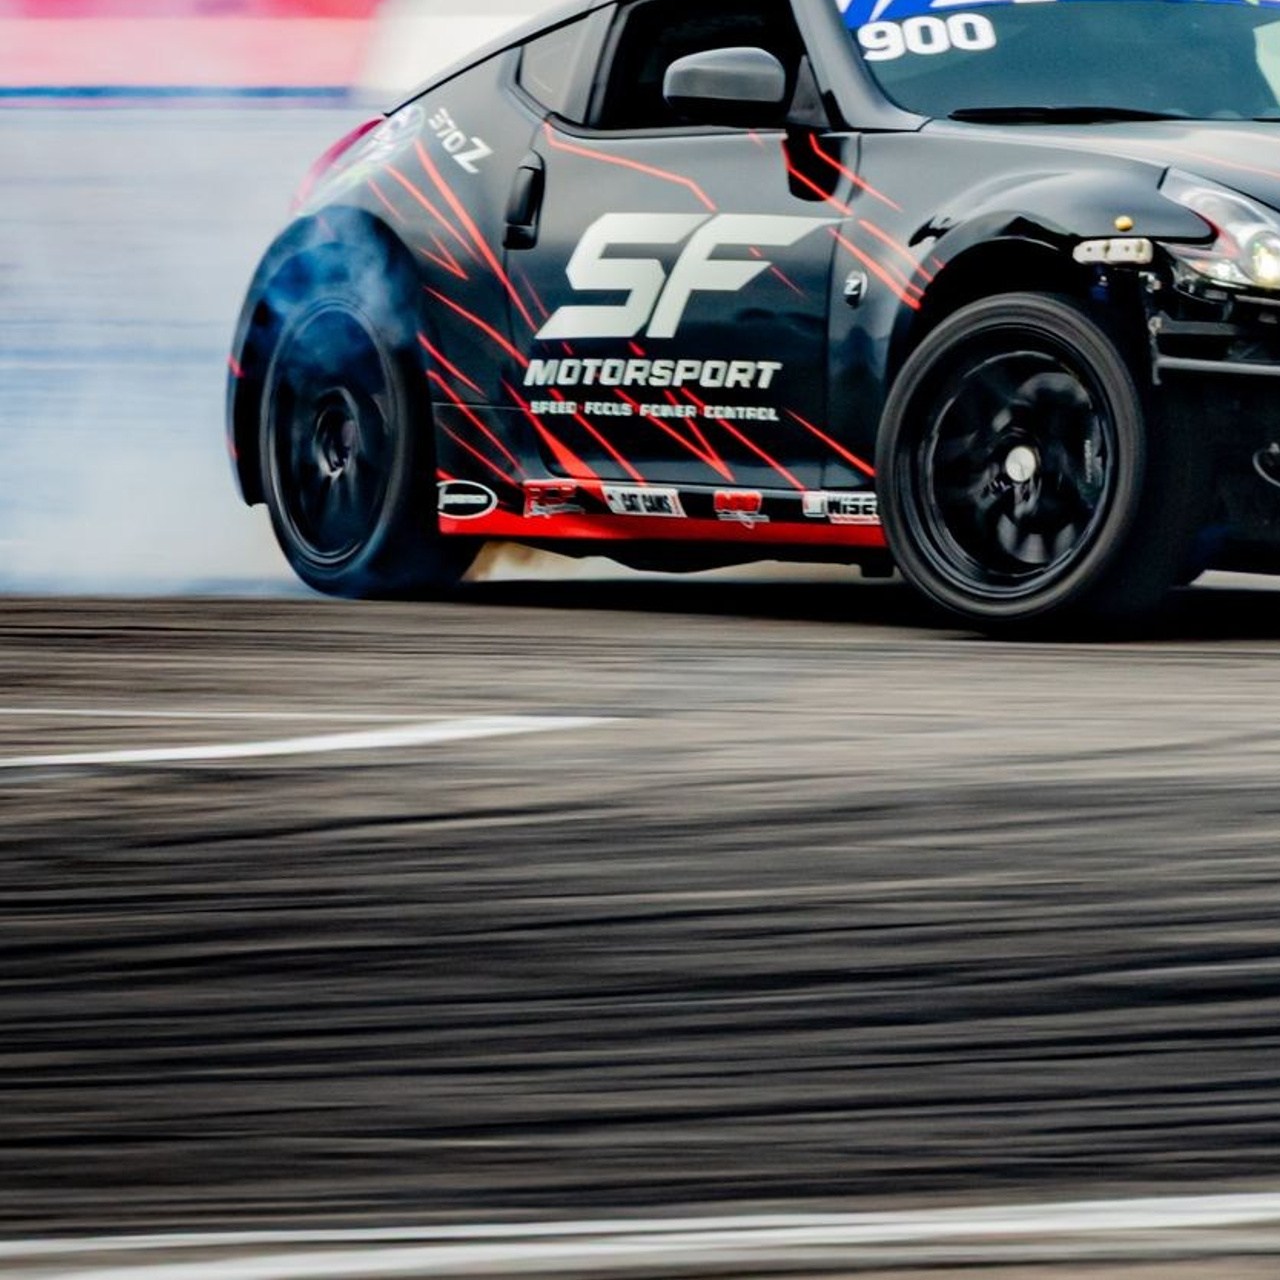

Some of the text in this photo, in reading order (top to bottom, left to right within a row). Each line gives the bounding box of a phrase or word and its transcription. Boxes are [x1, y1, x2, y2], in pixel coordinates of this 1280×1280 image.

[857, 12, 997, 62] 900
[428, 107, 494, 175] 370Z
[534, 212, 850, 340] SF
[523, 359, 783, 389] MOTORSPORT
